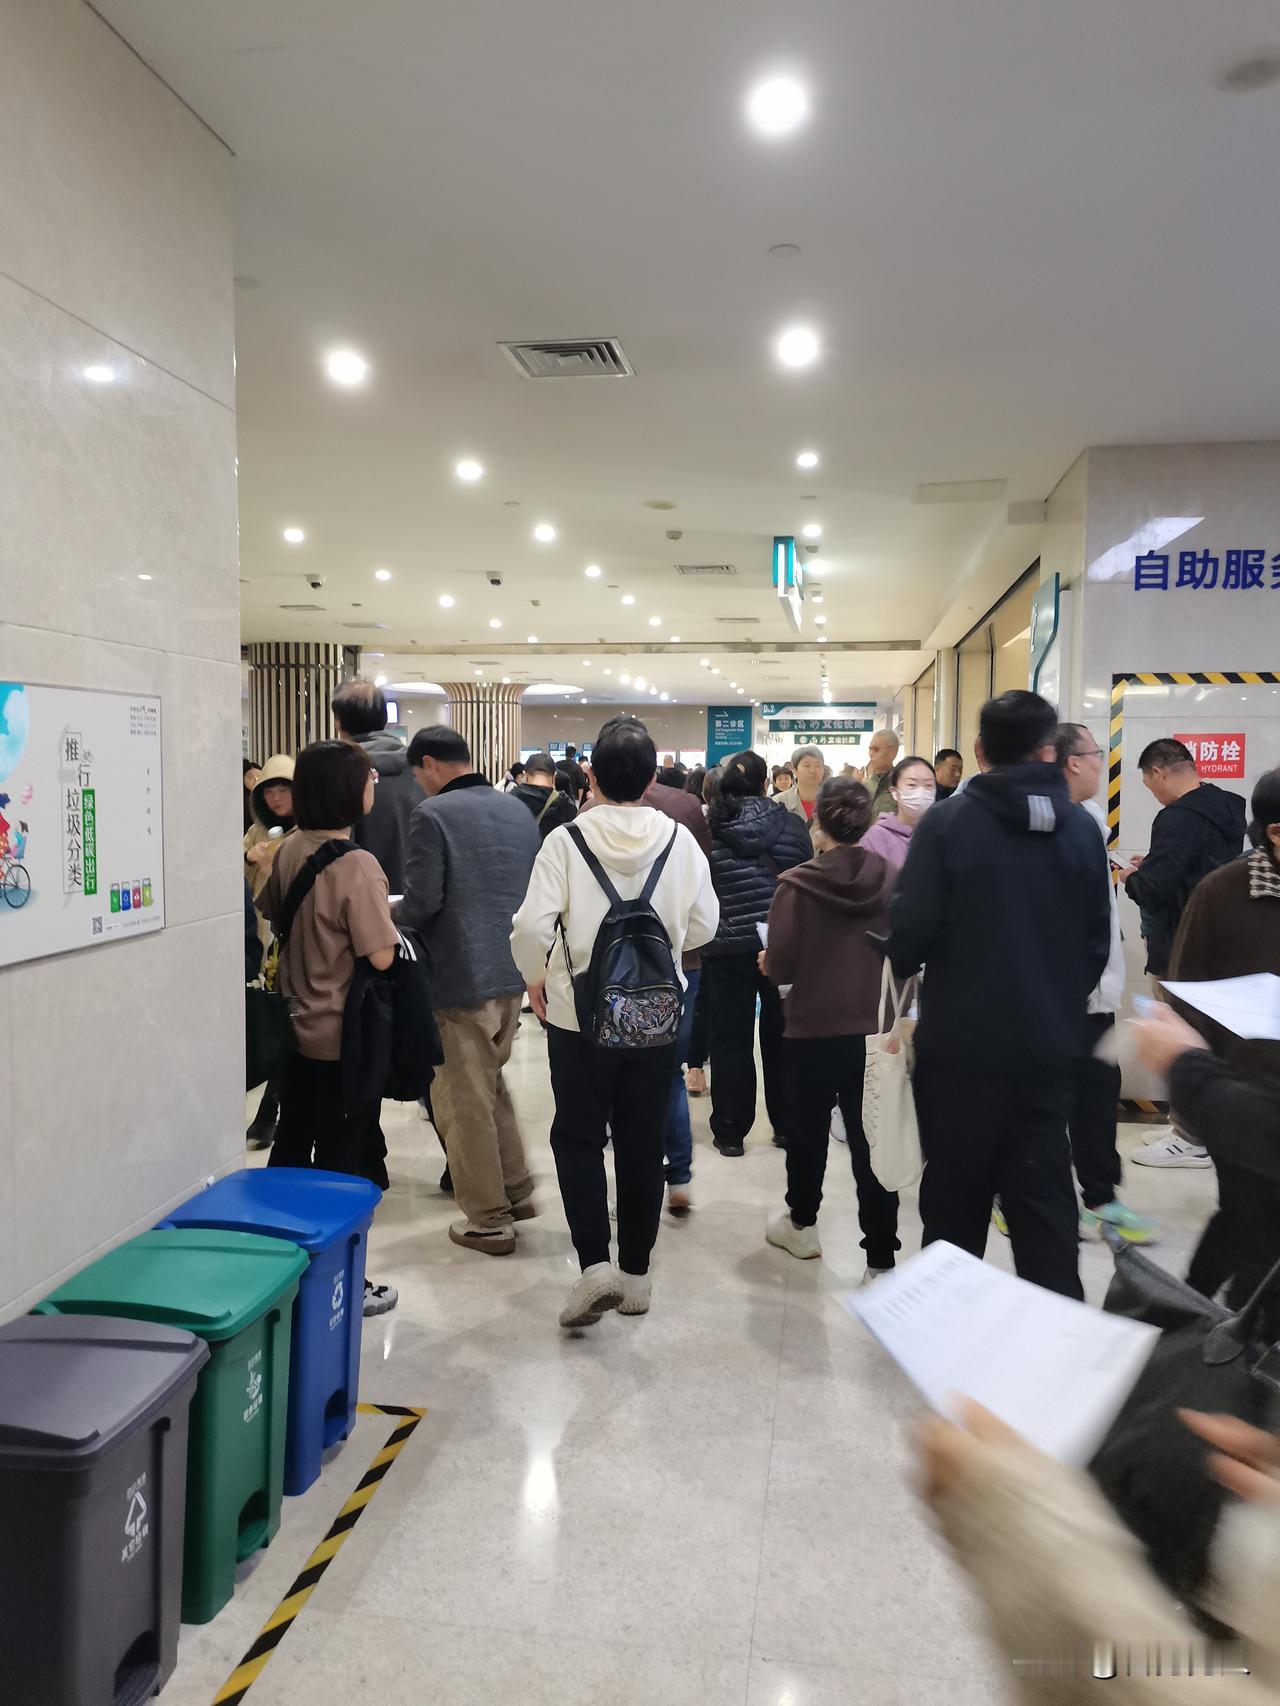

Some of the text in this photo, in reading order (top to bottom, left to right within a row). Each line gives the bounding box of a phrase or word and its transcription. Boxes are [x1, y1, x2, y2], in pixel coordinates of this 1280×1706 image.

[1135, 549, 1280, 591] 自助服
[1201, 764, 1238, 773] HYDRANT
[84, 793, 96, 891] 绿色低碳出行
